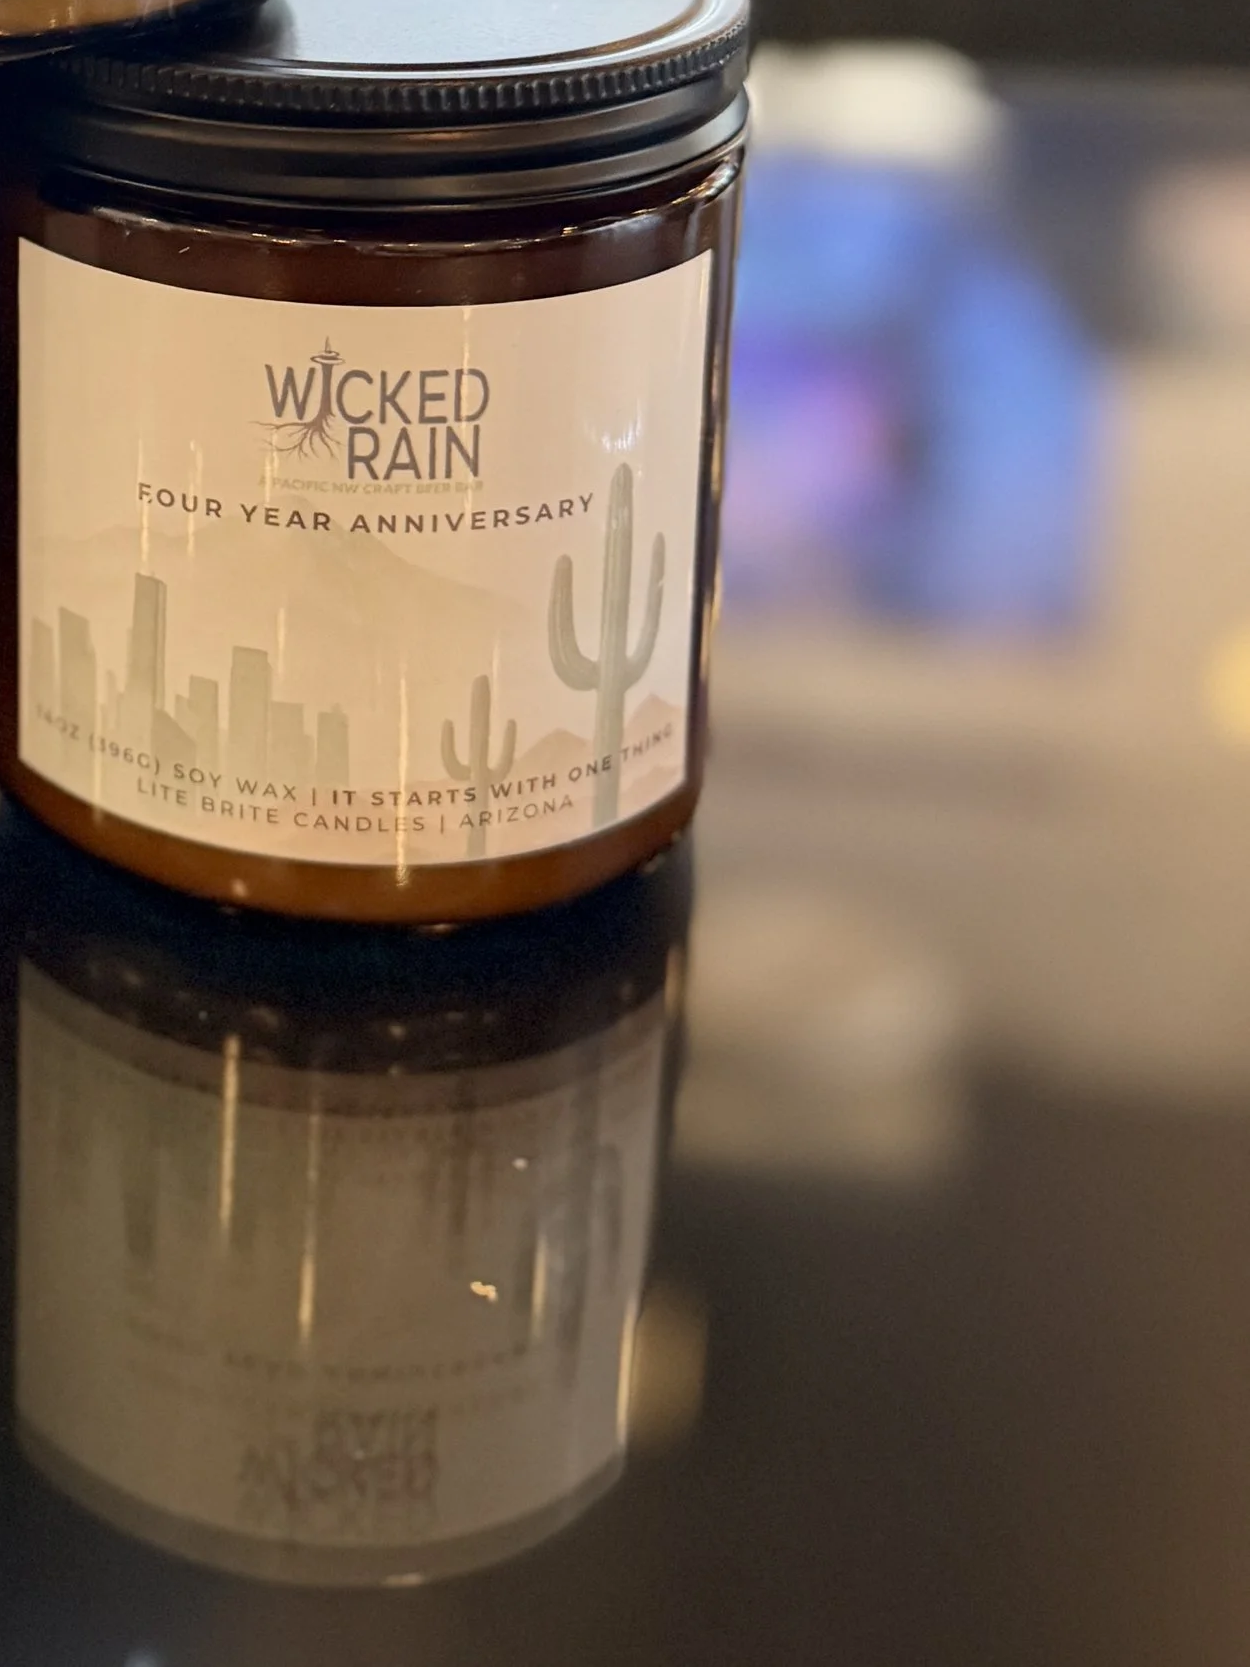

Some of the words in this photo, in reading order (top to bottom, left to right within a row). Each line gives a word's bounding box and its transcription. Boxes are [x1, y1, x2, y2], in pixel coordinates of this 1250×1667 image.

[264, 363, 491, 425] WICKED
[347, 423, 481, 481] RAIN
[137, 481, 223, 518] FOUR
[239, 503, 331, 532] YEAR
[349, 492, 595, 534] ANNIVERSARY
[273, 478, 328, 493] PACIFIC
[331, 482, 358, 494] NW
[362, 483, 411, 495] CRAFT
[173, 762, 223, 790] SOY
[235, 776, 297, 801] WAX
[332, 789, 358, 806] IT
[370, 786, 477, 807] STARTS
[490, 773, 557, 800] WITH
[568, 754, 613, 783] ONE
[620, 722, 673, 763] THING
[137, 775, 188, 807] LITE
[201, 795, 280, 825] BRITE
[293, 812, 425, 833] CANDLES
[458, 793, 575, 829] ARIZONA
